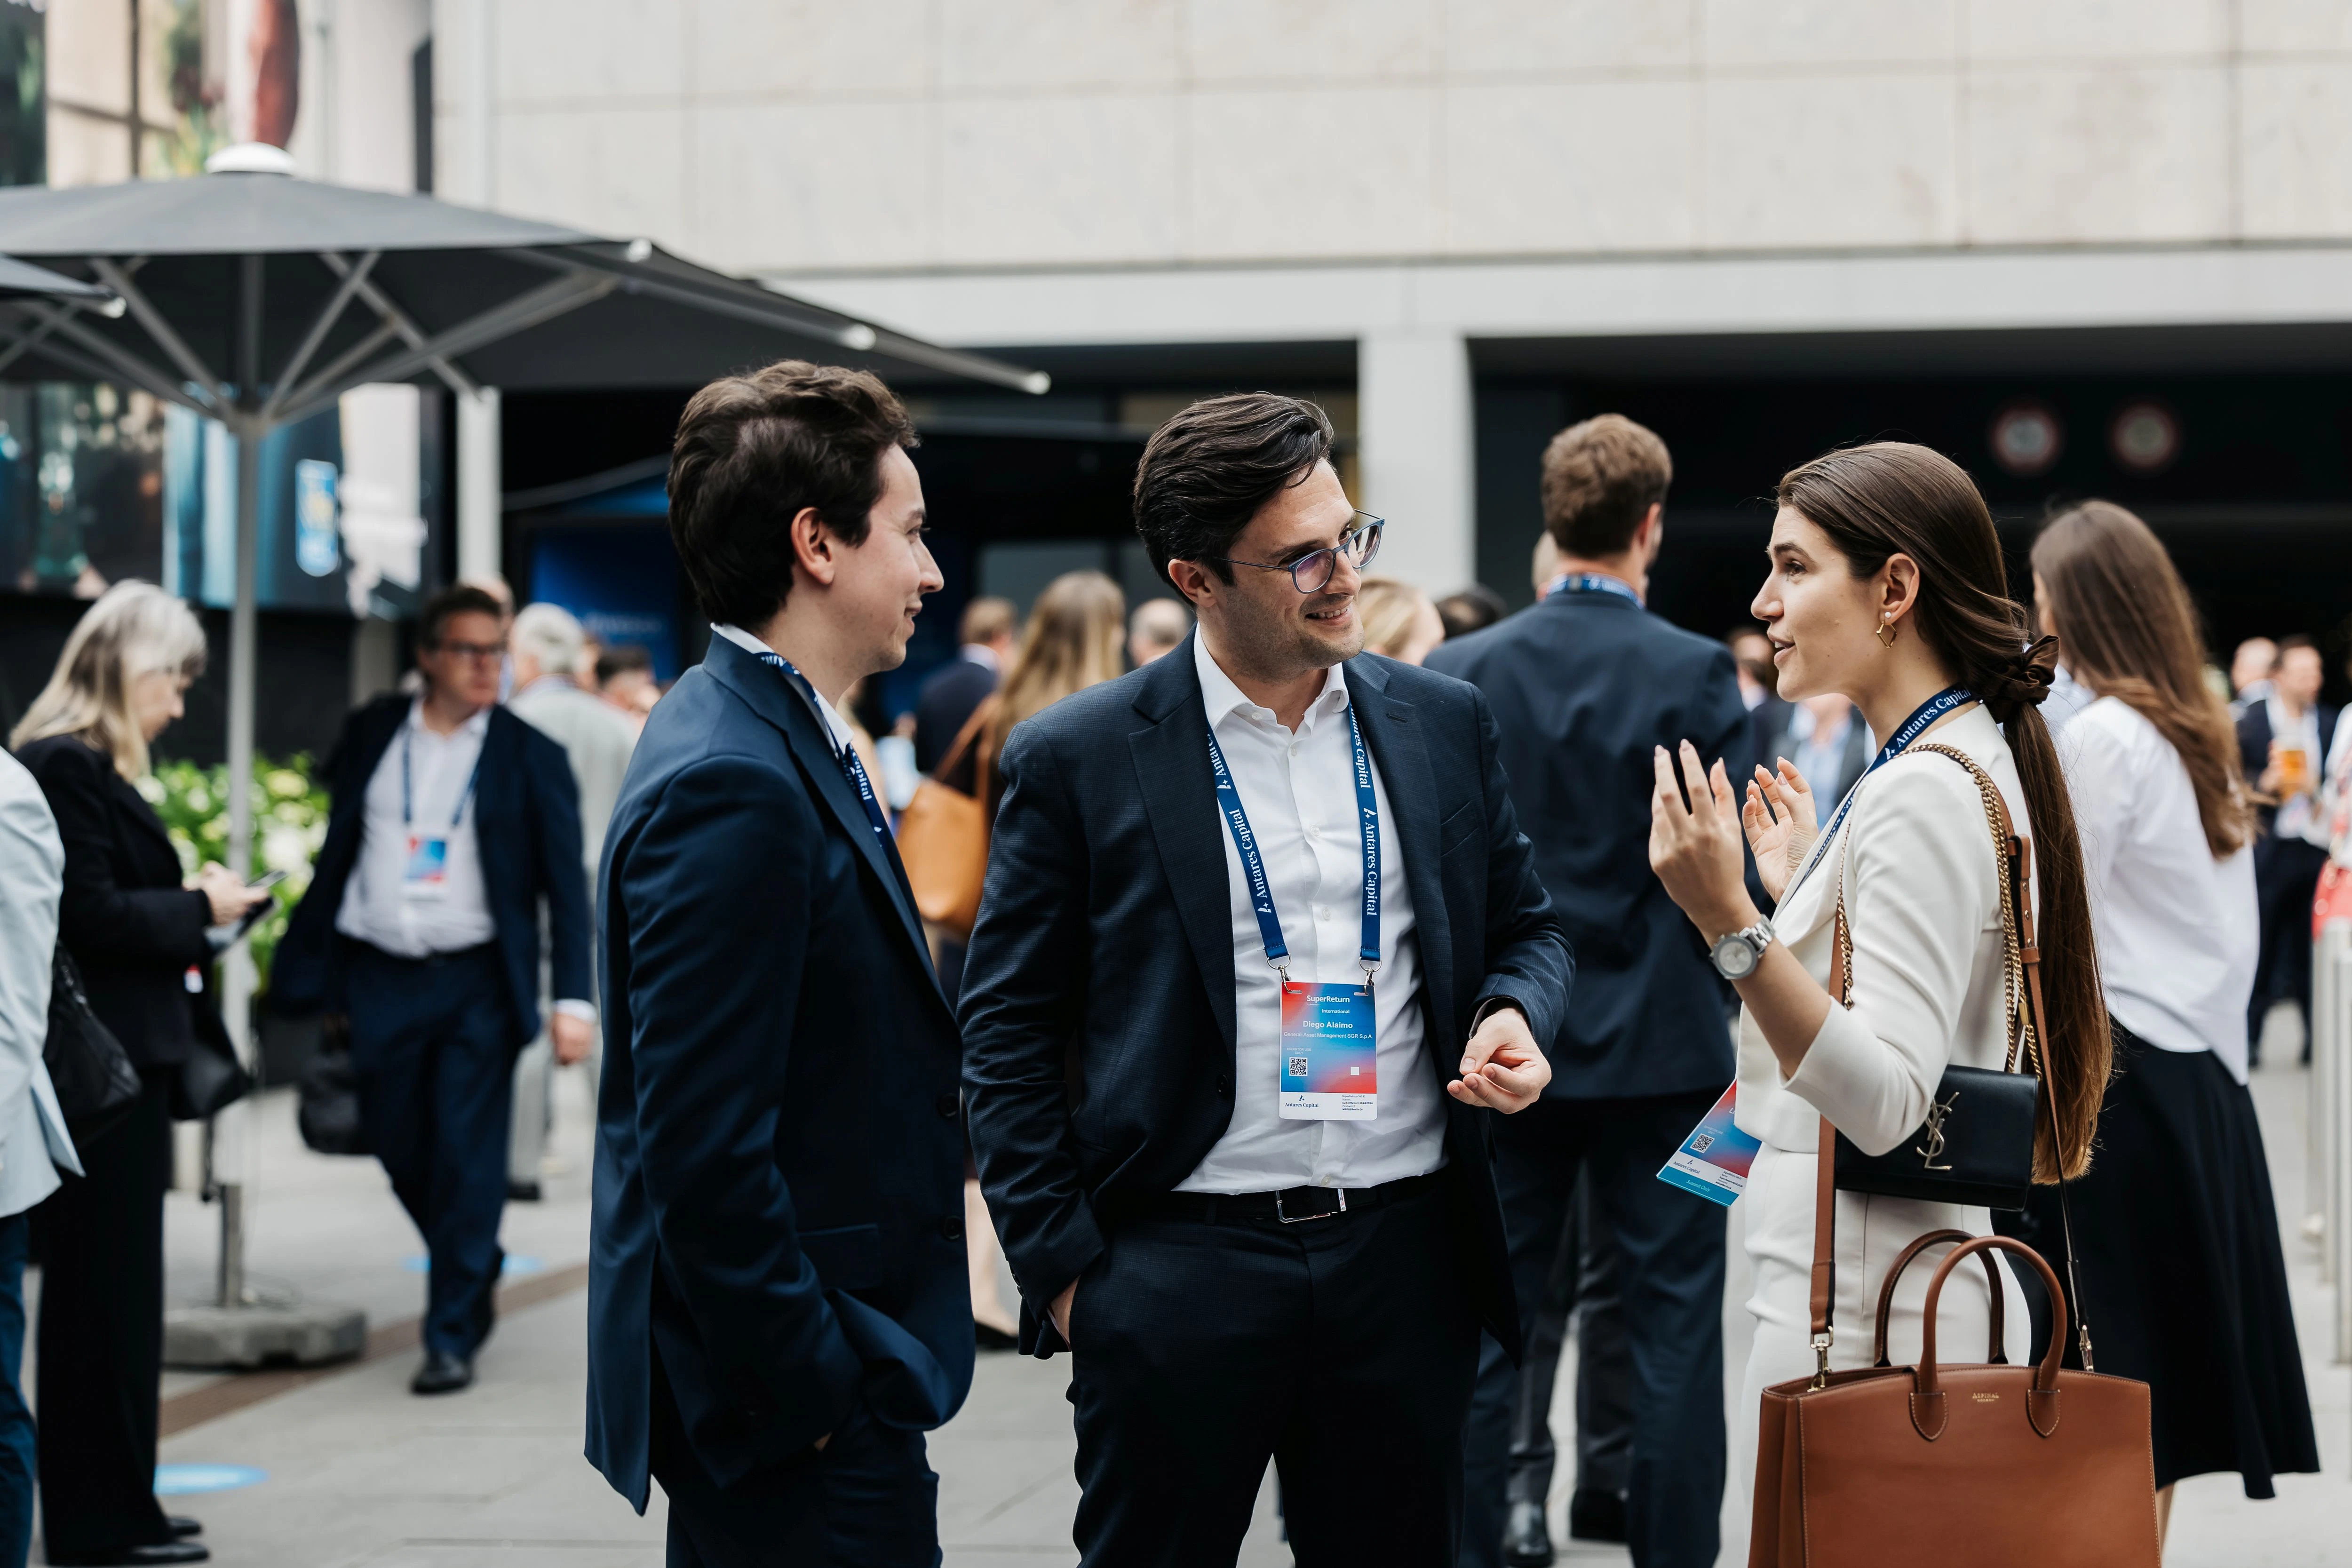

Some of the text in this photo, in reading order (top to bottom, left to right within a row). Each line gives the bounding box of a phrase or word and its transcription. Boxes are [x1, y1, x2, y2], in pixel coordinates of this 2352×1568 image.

[1351, 704, 1371, 788] tares Capital
[1896, 688, 1971, 747] Antares Capital
[1229, 809, 1267, 898] Antares Capital
[1365, 822, 1377, 915] Antares Capital
[1303, 1020, 1325, 1029] Diego
